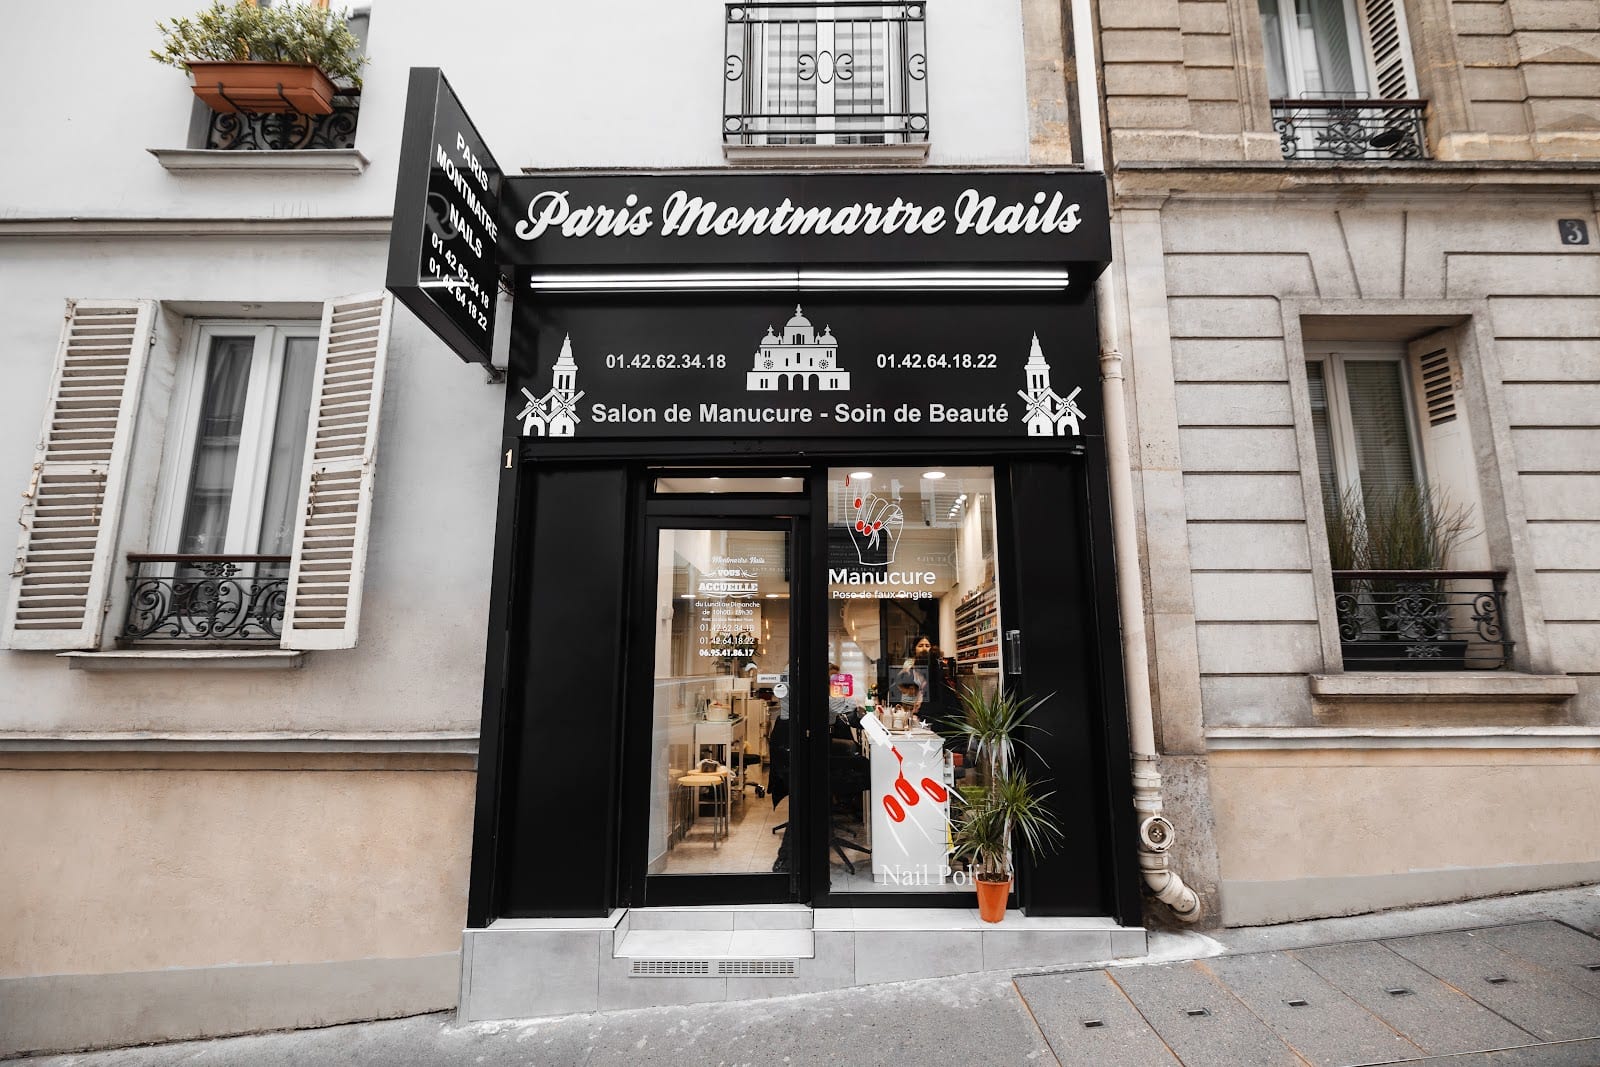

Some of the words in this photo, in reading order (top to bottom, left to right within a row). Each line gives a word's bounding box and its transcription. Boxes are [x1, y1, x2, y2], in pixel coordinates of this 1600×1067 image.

[456, 131, 489, 192] PARIS
[436, 143, 498, 244] MONTMATRE
[515, 190, 653, 241] Paris
[661, 190, 947, 237] Montmartre
[954, 188, 1082, 235] Nails
[449, 202, 483, 259] NAILS
[1566, 220, 1583, 243] 3
[431, 232, 443, 255] 01
[445, 250, 457, 271] 42
[457, 263, 469, 284] 62
[469, 276, 480, 297] 34
[480, 290, 489, 309] 18
[429, 257, 441, 279] 01
[455, 287, 466, 307] 64
[467, 300, 478, 319] 18
[477, 312, 488, 332] 22
[606, 354, 727, 369] 01.42.62.34.18
[876, 353, 998, 369] 01.42.64.18.22
[591, 403, 657, 423] Salon
[663, 403, 692, 423] de
[700, 403, 813, 423] Manucure
[834, 403, 886, 423] Soin
[893, 403, 922, 423] de
[929, 403, 1009, 423] Beauté
[504, 448, 513, 469] 1
[718, 569, 740, 577] VOUS
[828, 568, 937, 586] Manucure
[698, 583, 758, 591] ACCUEILLE
[832, 590, 857, 599] Pose
[860, 590, 872, 599] de
[874, 590, 896, 599] faux
[898, 590, 933, 601] Ongles
[880, 863, 929, 886] Nail
